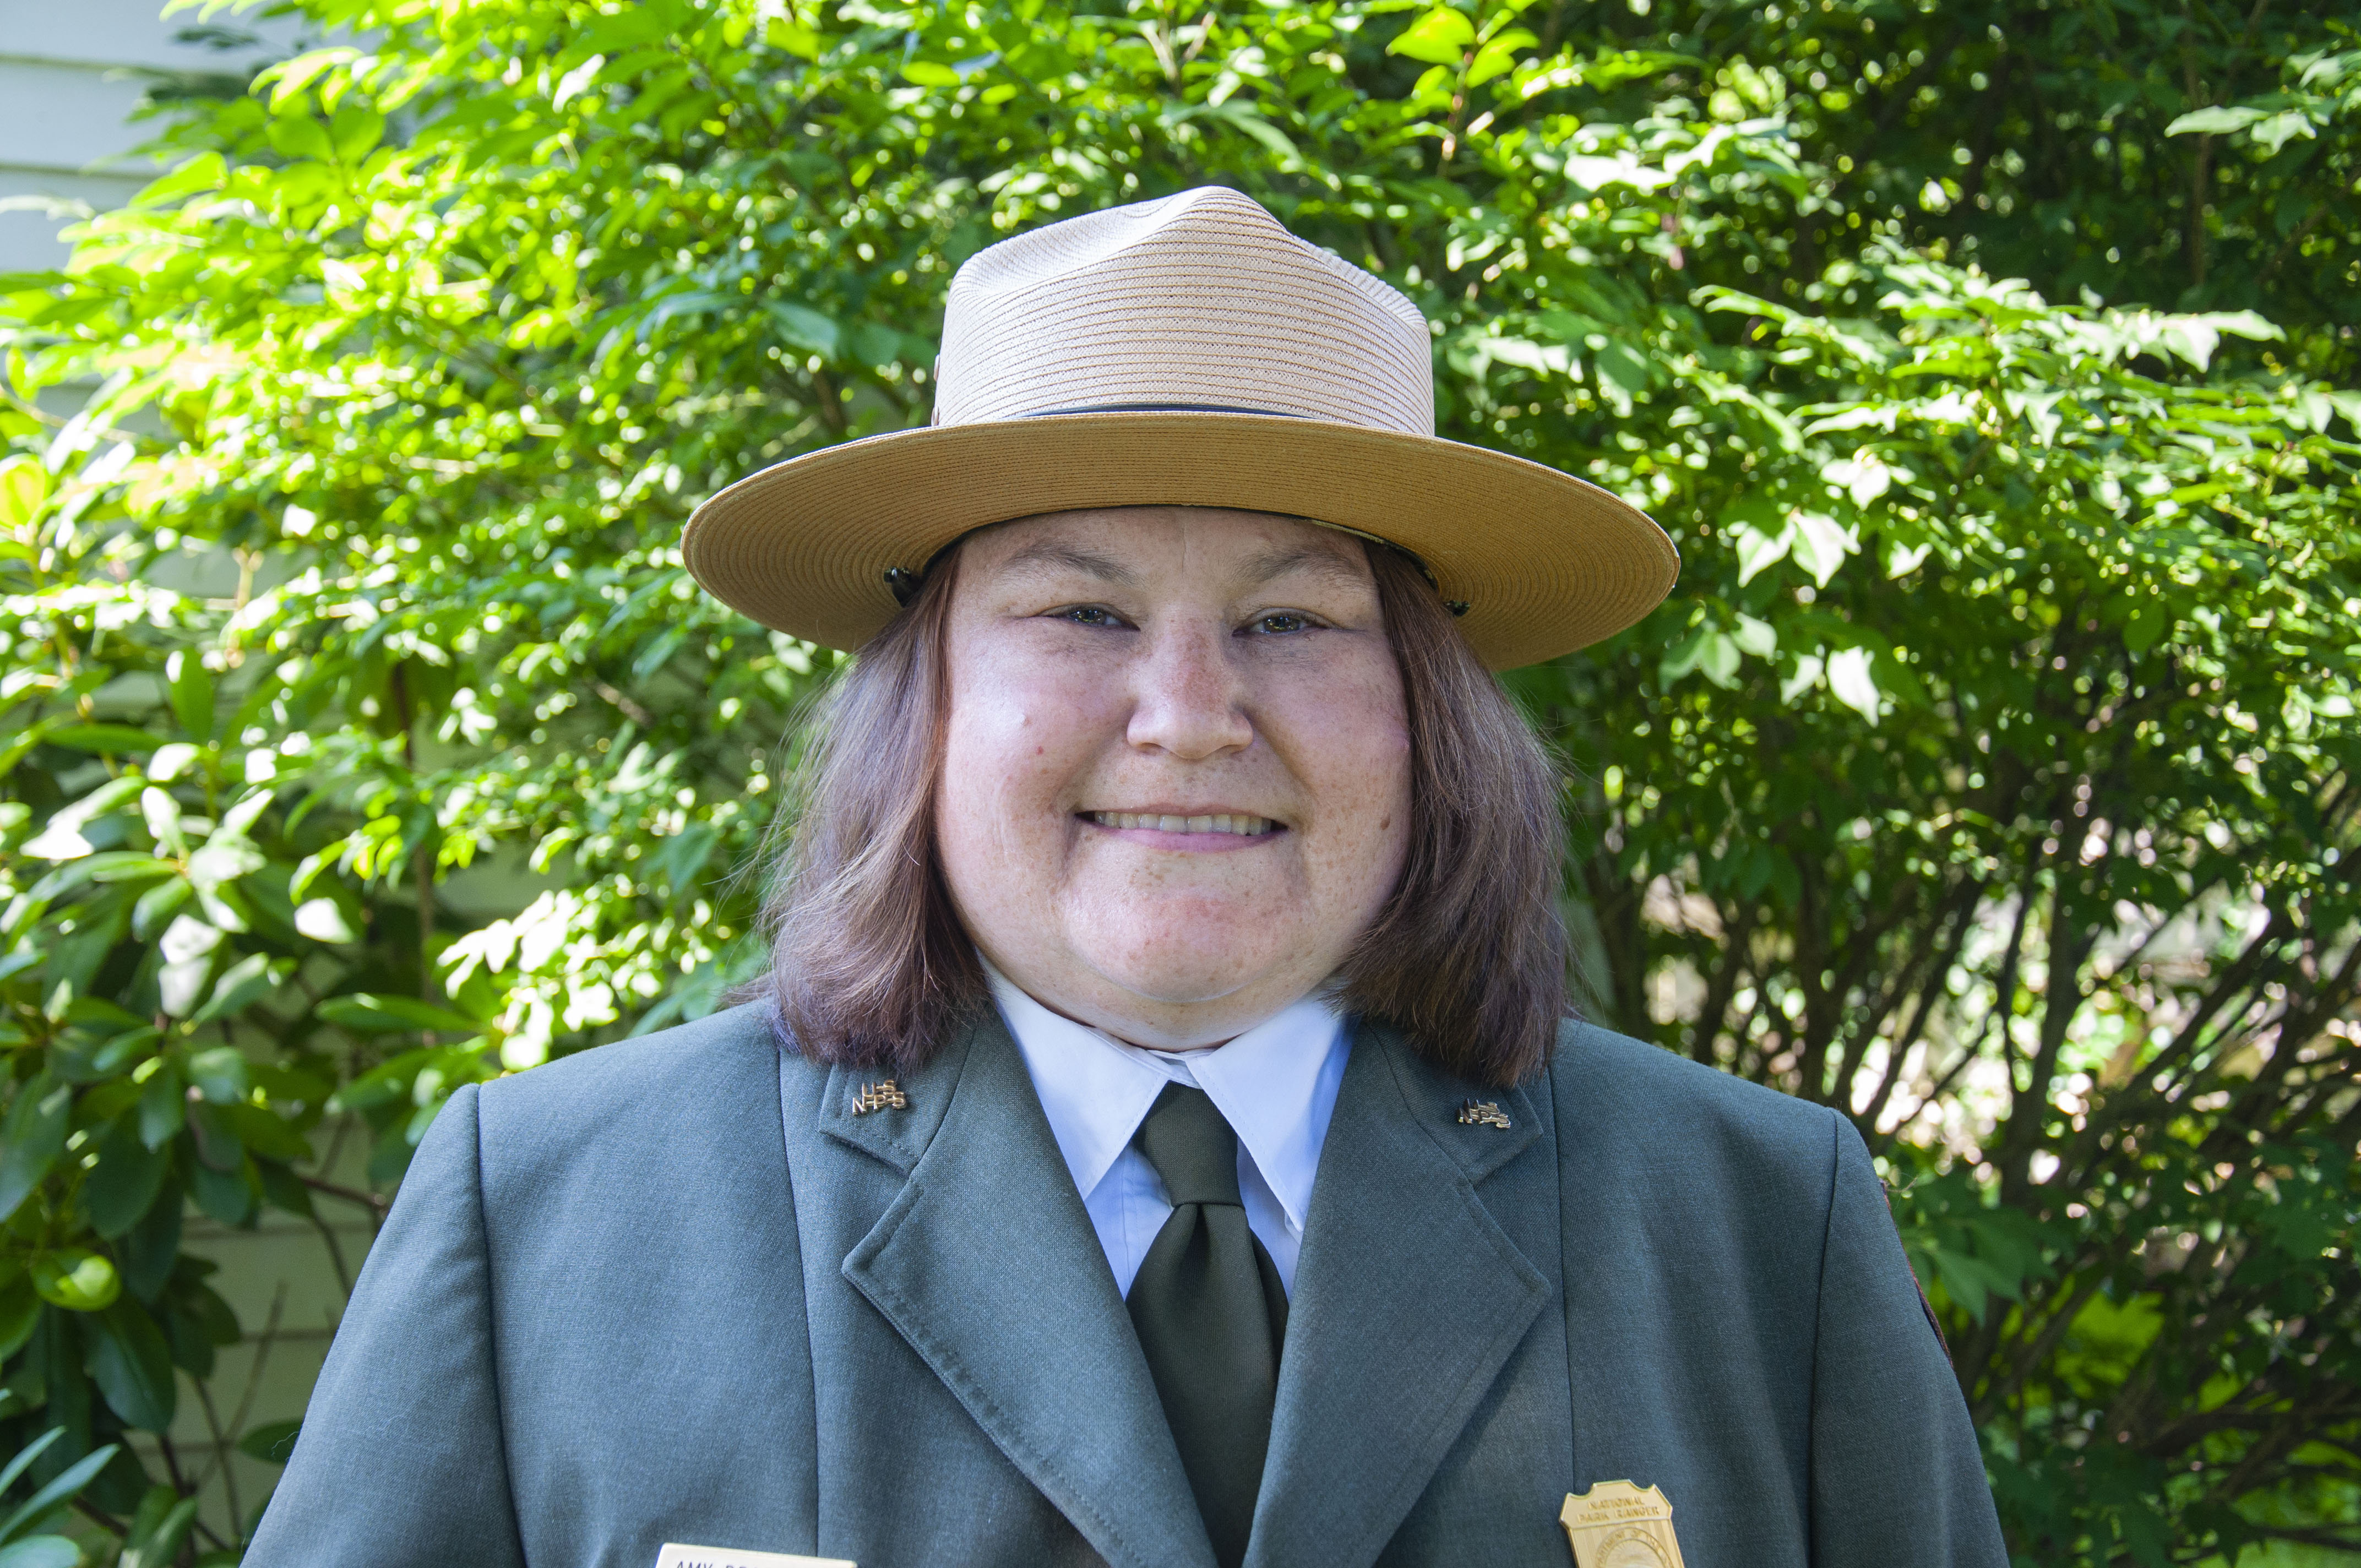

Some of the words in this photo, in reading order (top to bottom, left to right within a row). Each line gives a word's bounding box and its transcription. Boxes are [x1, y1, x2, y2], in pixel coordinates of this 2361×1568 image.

[852, 1091, 907, 1115] NPS
[1588, 1496, 1645, 1510] NATIONAL
[1577, 1513, 1609, 1524] PARK
[1614, 1506, 1660, 1518] RANGER
